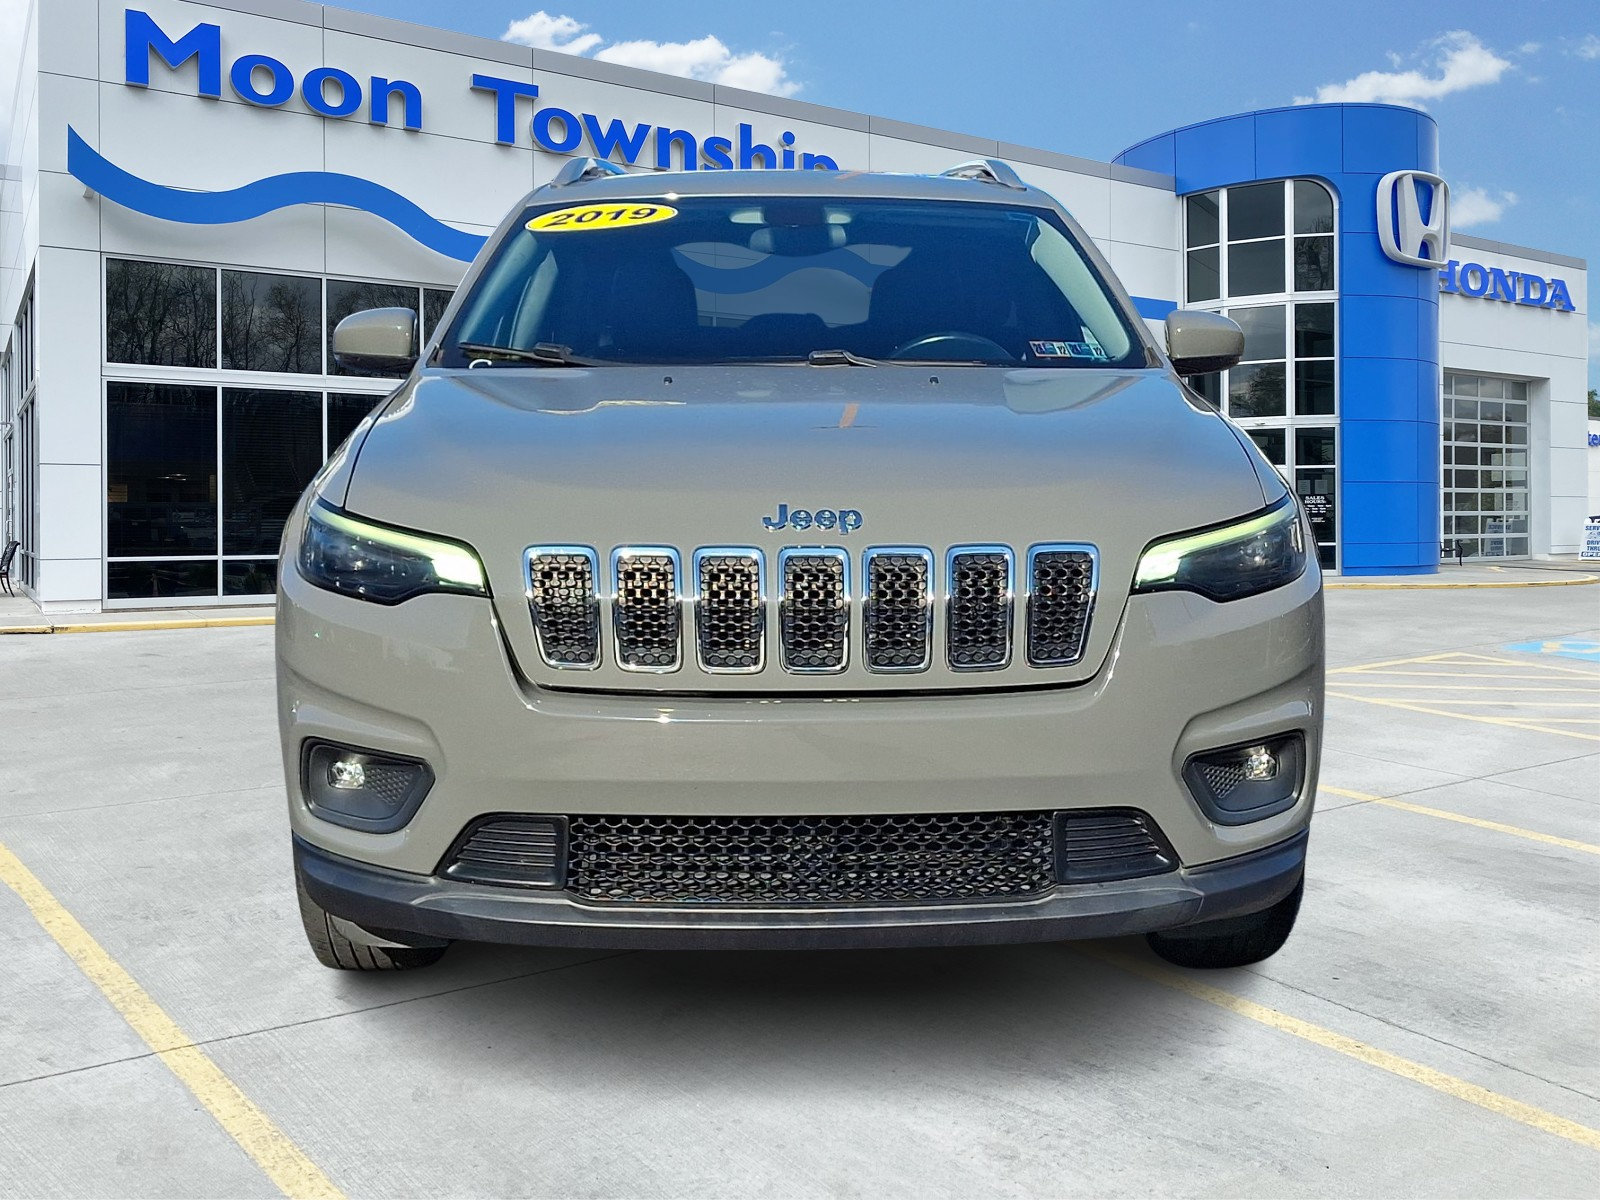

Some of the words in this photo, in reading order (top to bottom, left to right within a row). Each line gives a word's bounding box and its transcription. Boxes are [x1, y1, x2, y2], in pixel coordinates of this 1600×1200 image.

[125, 8, 422, 132] Moon
[543, 207, 658, 228] 2019
[762, 503, 864, 535] Jeep
